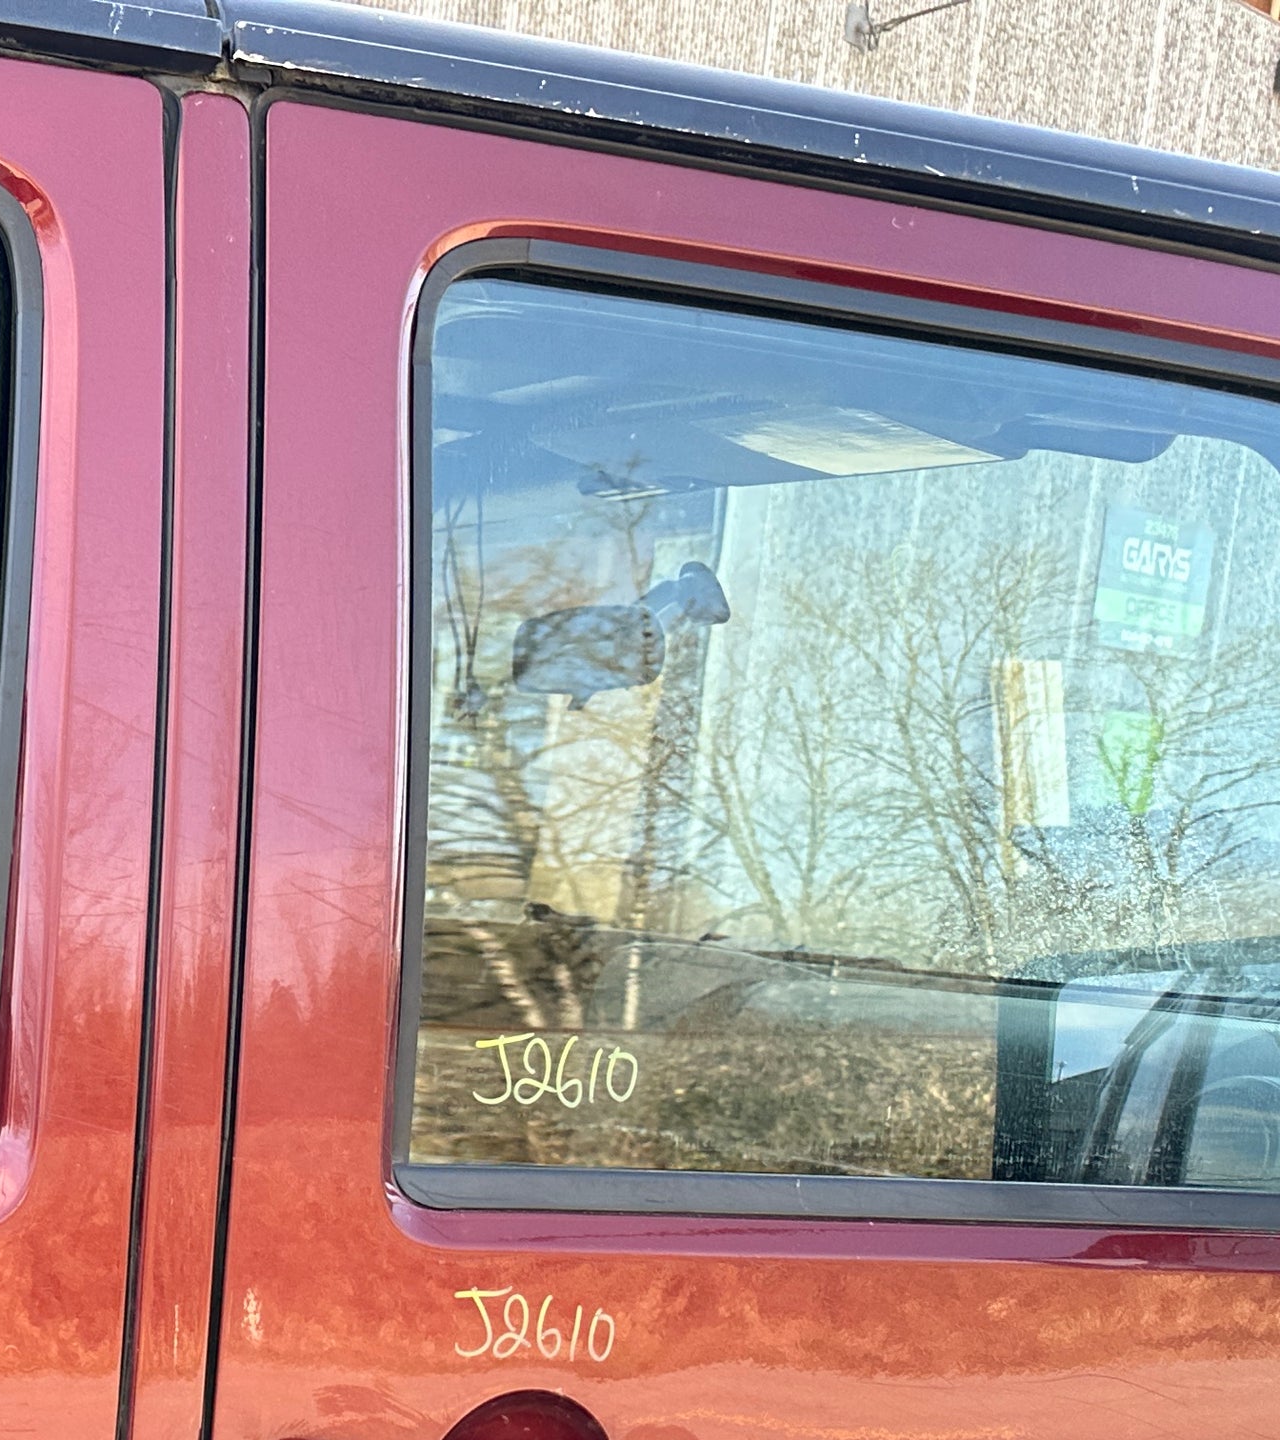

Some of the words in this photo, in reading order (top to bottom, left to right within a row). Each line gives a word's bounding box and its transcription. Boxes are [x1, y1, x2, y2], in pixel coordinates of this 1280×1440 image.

[1122, 537, 1192, 582] GARYS
[473, 1032, 639, 1108] J2610
[454, 1286, 615, 1362] J2610
